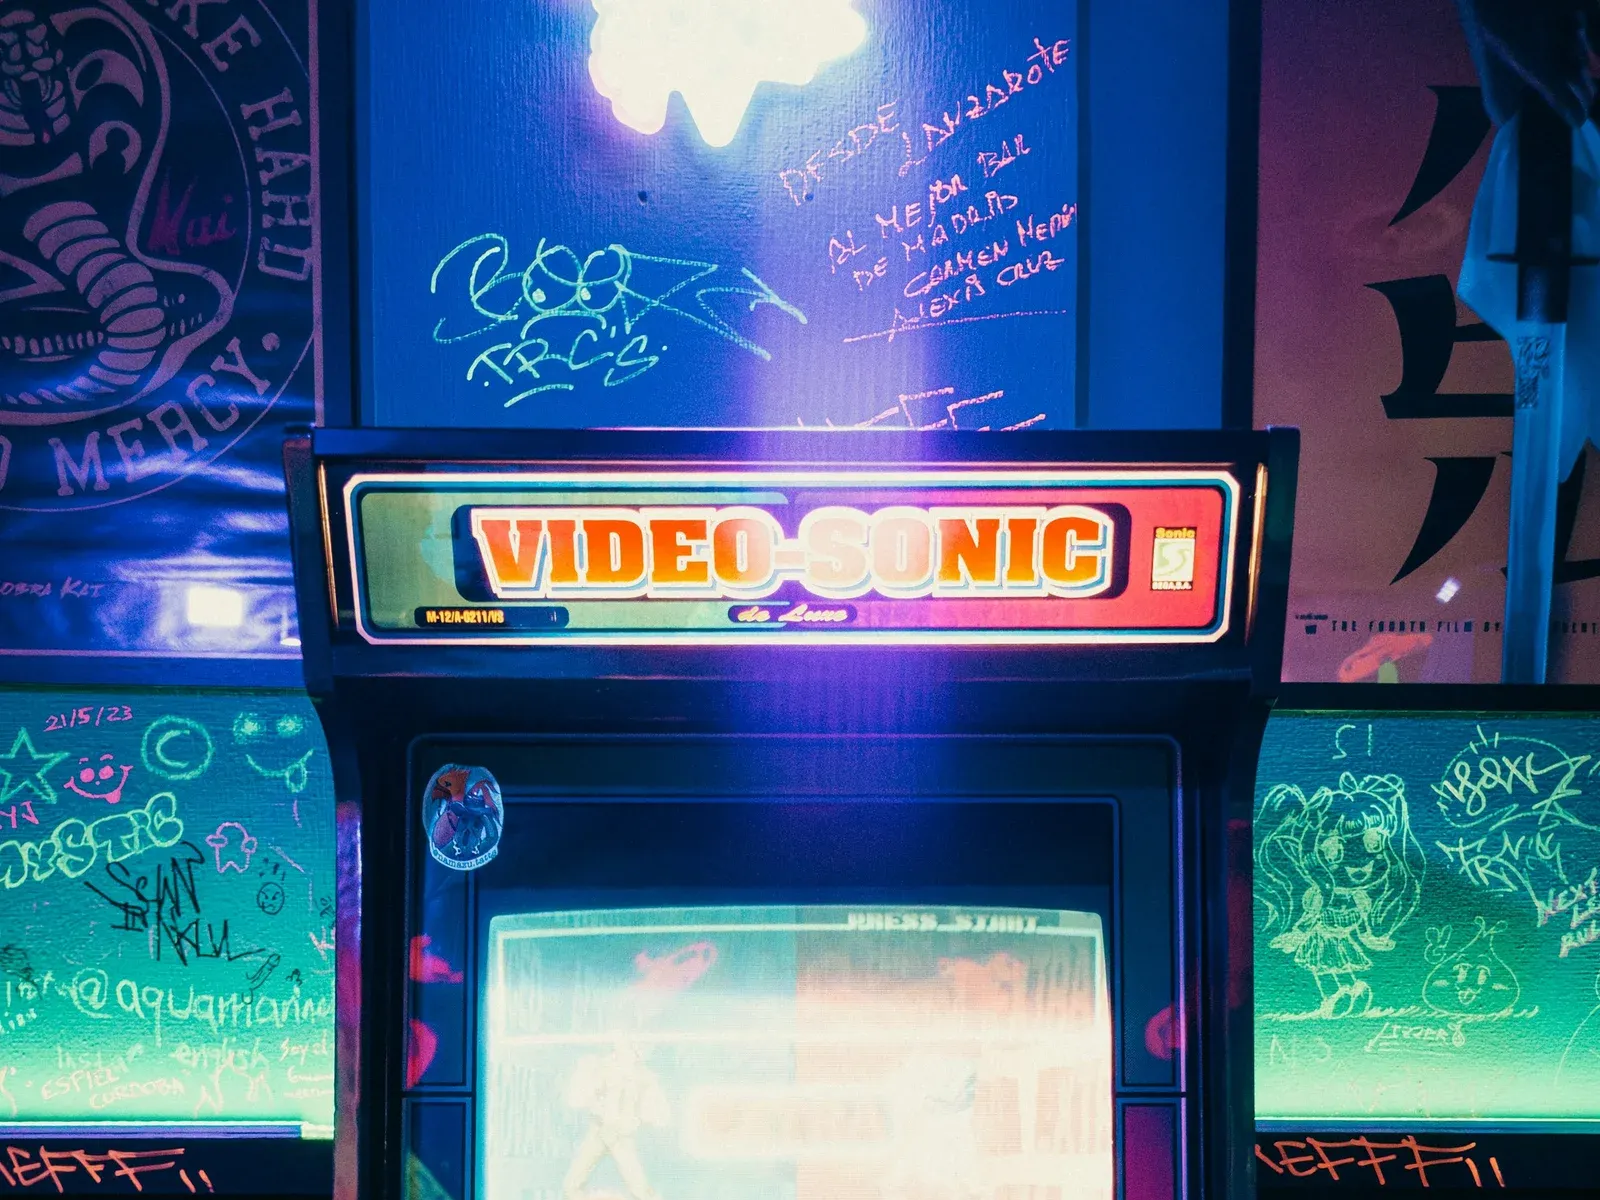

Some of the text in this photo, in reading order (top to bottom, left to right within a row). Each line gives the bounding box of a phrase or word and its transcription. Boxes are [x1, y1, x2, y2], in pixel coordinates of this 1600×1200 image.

[1155, 527, 1196, 539] Sonic
[471, 505, 1114, 599] VIDEO-SONIC
[43, 705, 133, 732] 21/5/23
